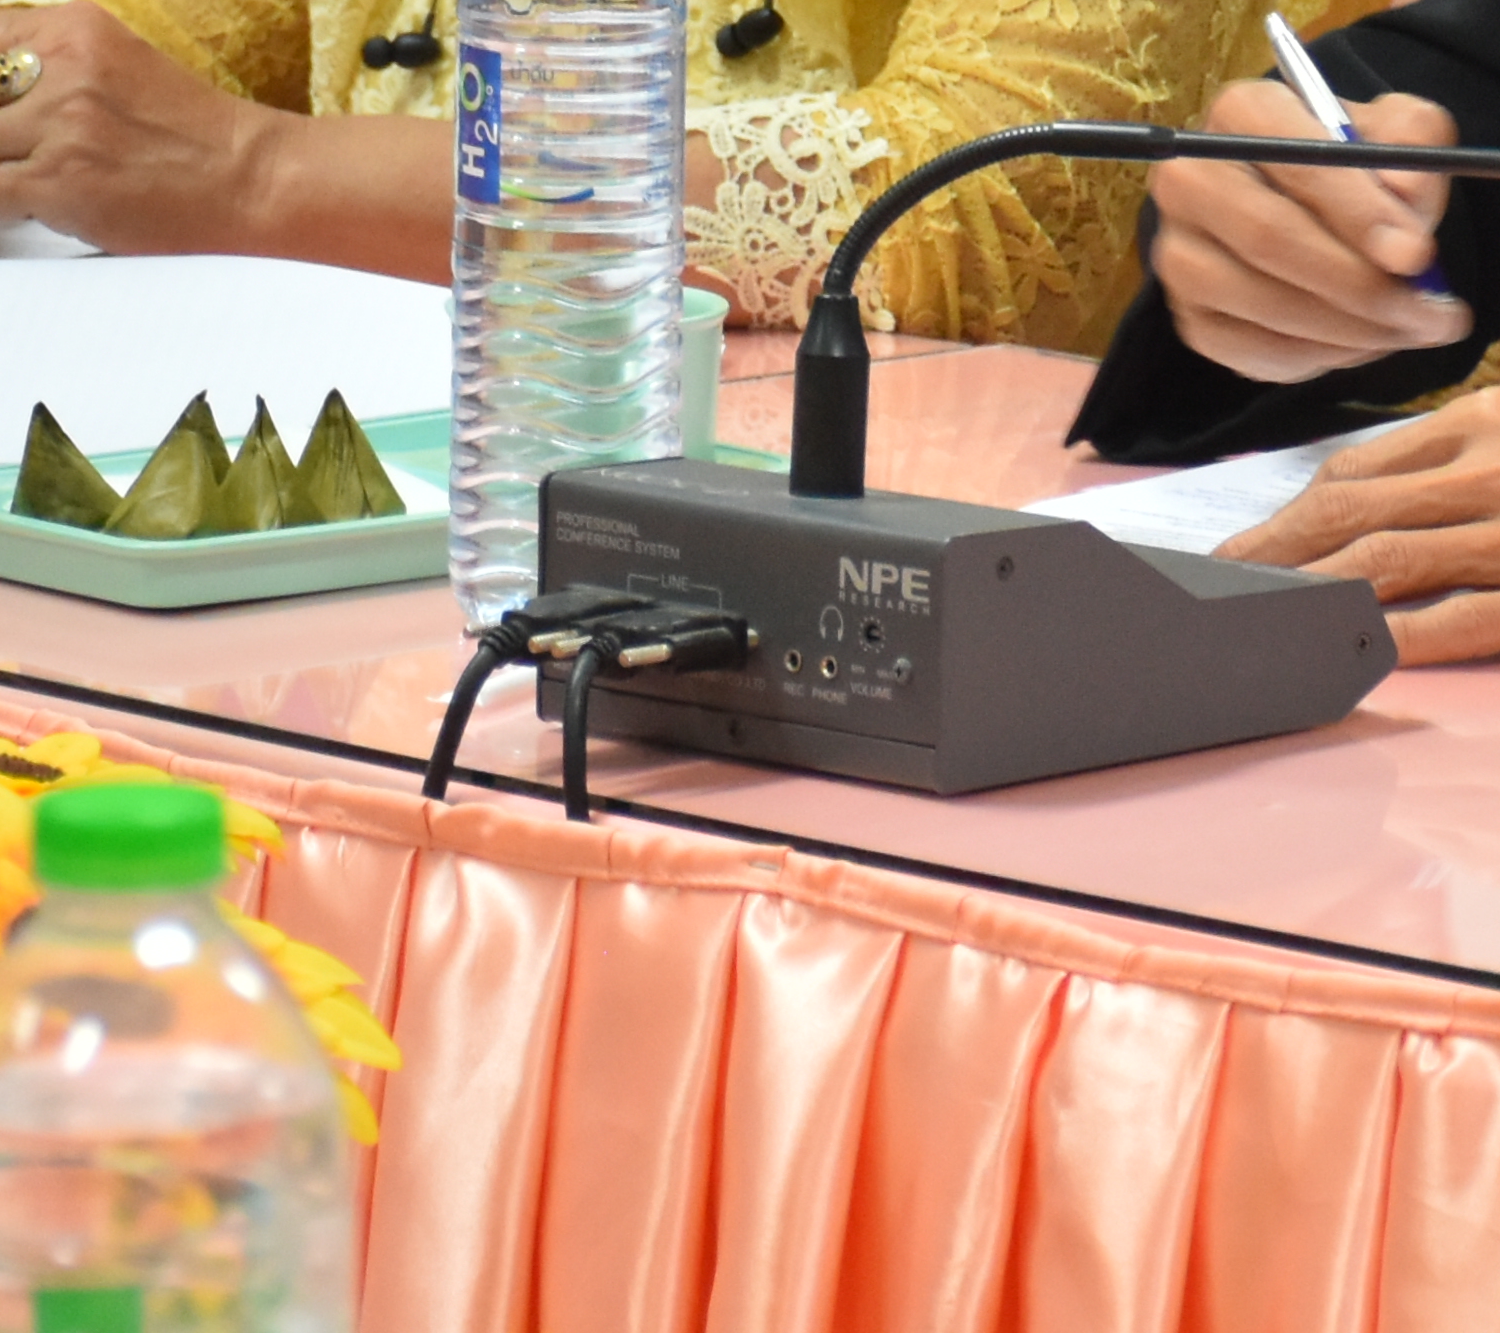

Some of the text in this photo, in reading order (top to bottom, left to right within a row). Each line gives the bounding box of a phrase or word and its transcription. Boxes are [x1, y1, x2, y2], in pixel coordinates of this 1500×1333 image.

[555, 510, 641, 538] PROFESSIONAL
[555, 527, 681, 561] CONFERENCE SYSTEM
[660, 573, 690, 593] LINE
[838, 555, 931, 605] NPE
[838, 590, 931, 617] RESEARCH
[811, 687, 848, 706] PHONE
[850, 683, 893, 701] VOLUME
